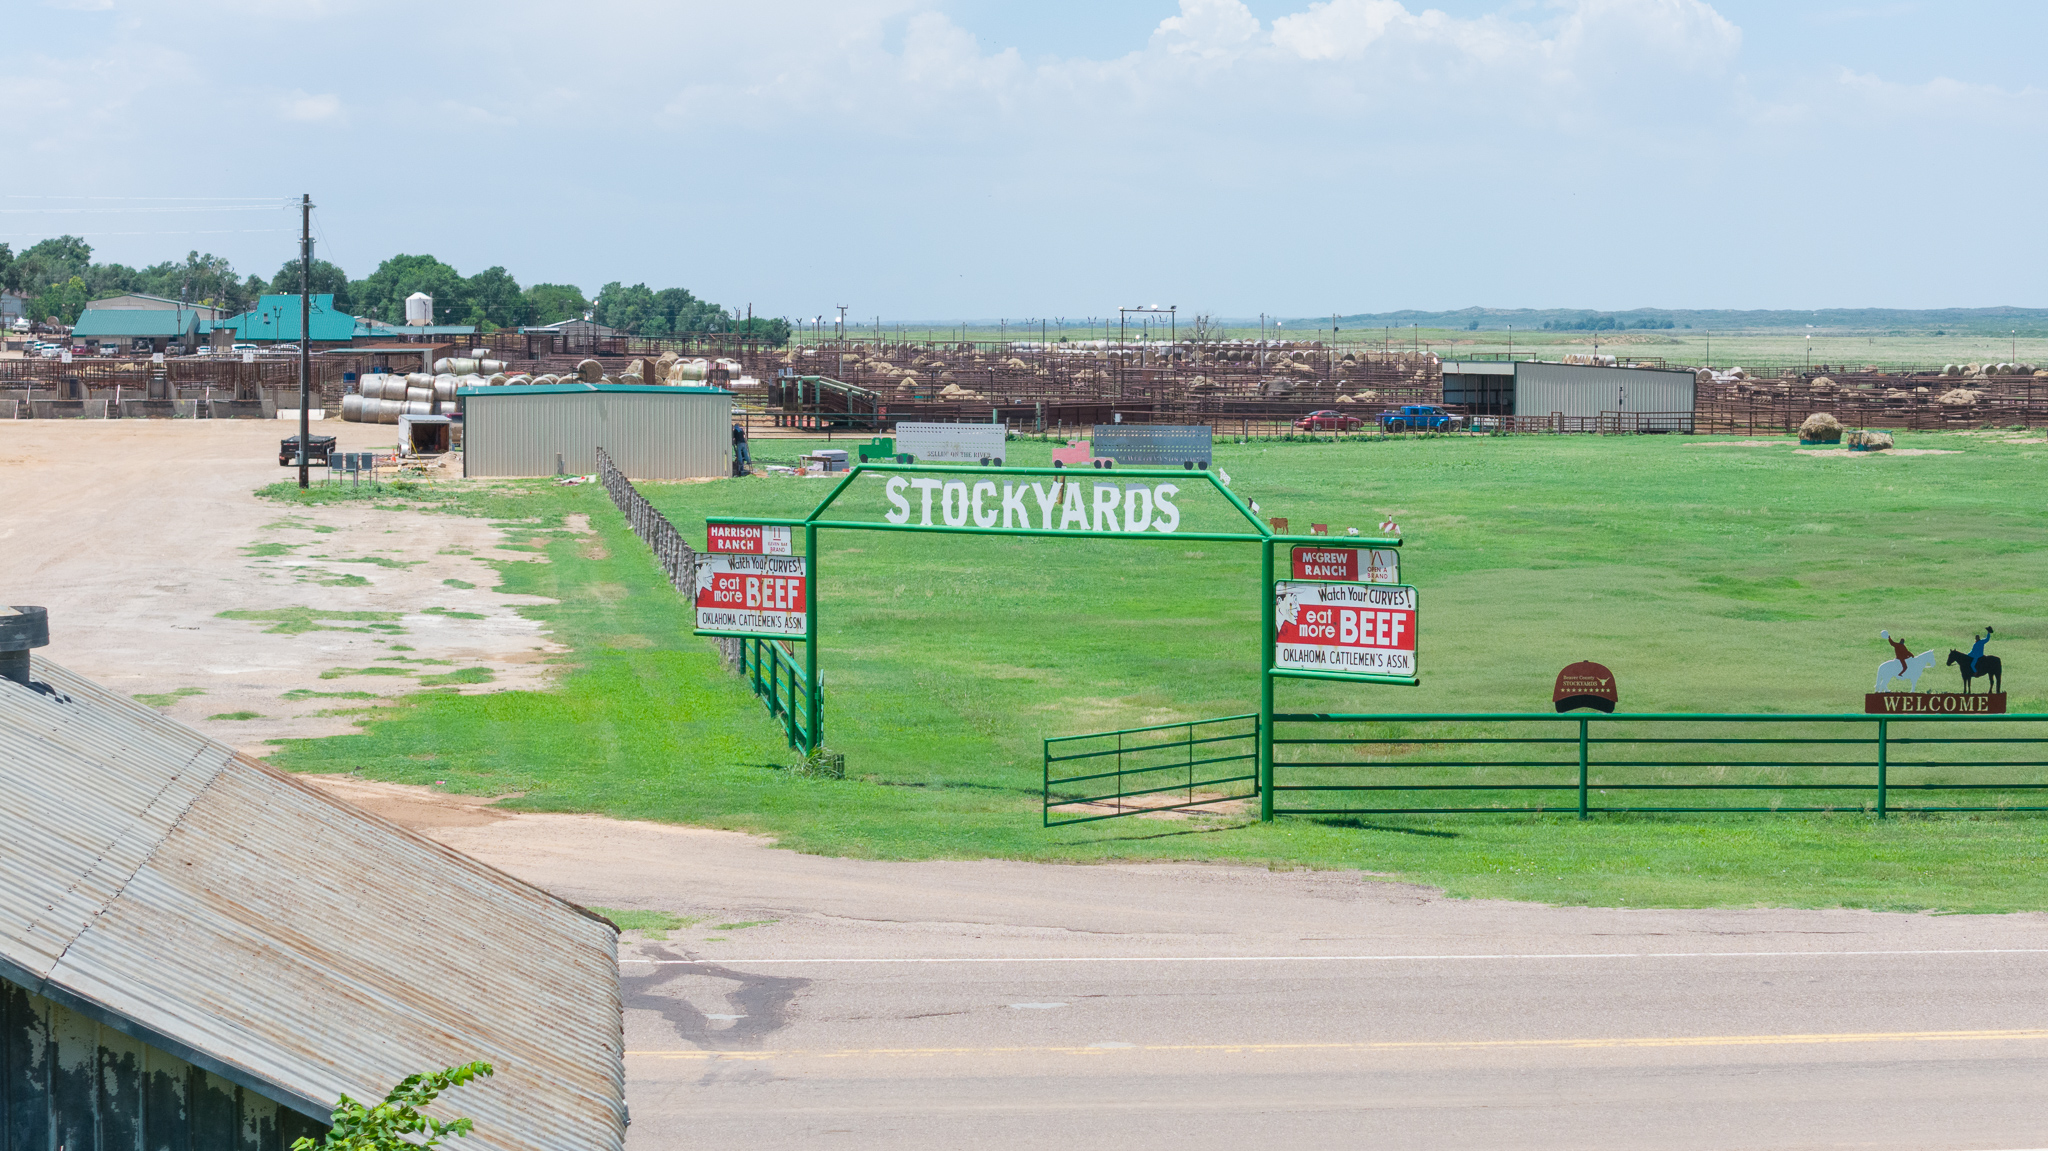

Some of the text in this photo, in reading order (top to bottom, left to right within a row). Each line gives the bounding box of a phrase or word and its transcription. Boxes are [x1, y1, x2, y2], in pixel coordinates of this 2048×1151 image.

[884, 475, 1180, 533] STOCKYARDS
[711, 526, 760, 538] HARRISON
[718, 539, 754, 550] RANCH
[728, 556, 804, 575] Watch Your CURVES!
[1302, 552, 1348, 564] McGREW
[1305, 565, 1347, 577] RANCH
[719, 577, 740, 590] eat
[714, 590, 743, 603] more
[746, 577, 799, 609] BEEF
[1318, 586, 1412, 608] Watch Your CURVES!
[702, 612, 736, 626] OKLAHOMA
[739, 613, 782, 628] CATTLEMEN'S
[1306, 609, 1332, 624] eat
[1299, 624, 1336, 638] more
[1340, 609, 1407, 646] BEEF
[1283, 648, 1410, 669] OKLAHOMA CATTLEMEN'S ASSN.
[1883, 696, 1989, 712] WELCOME
